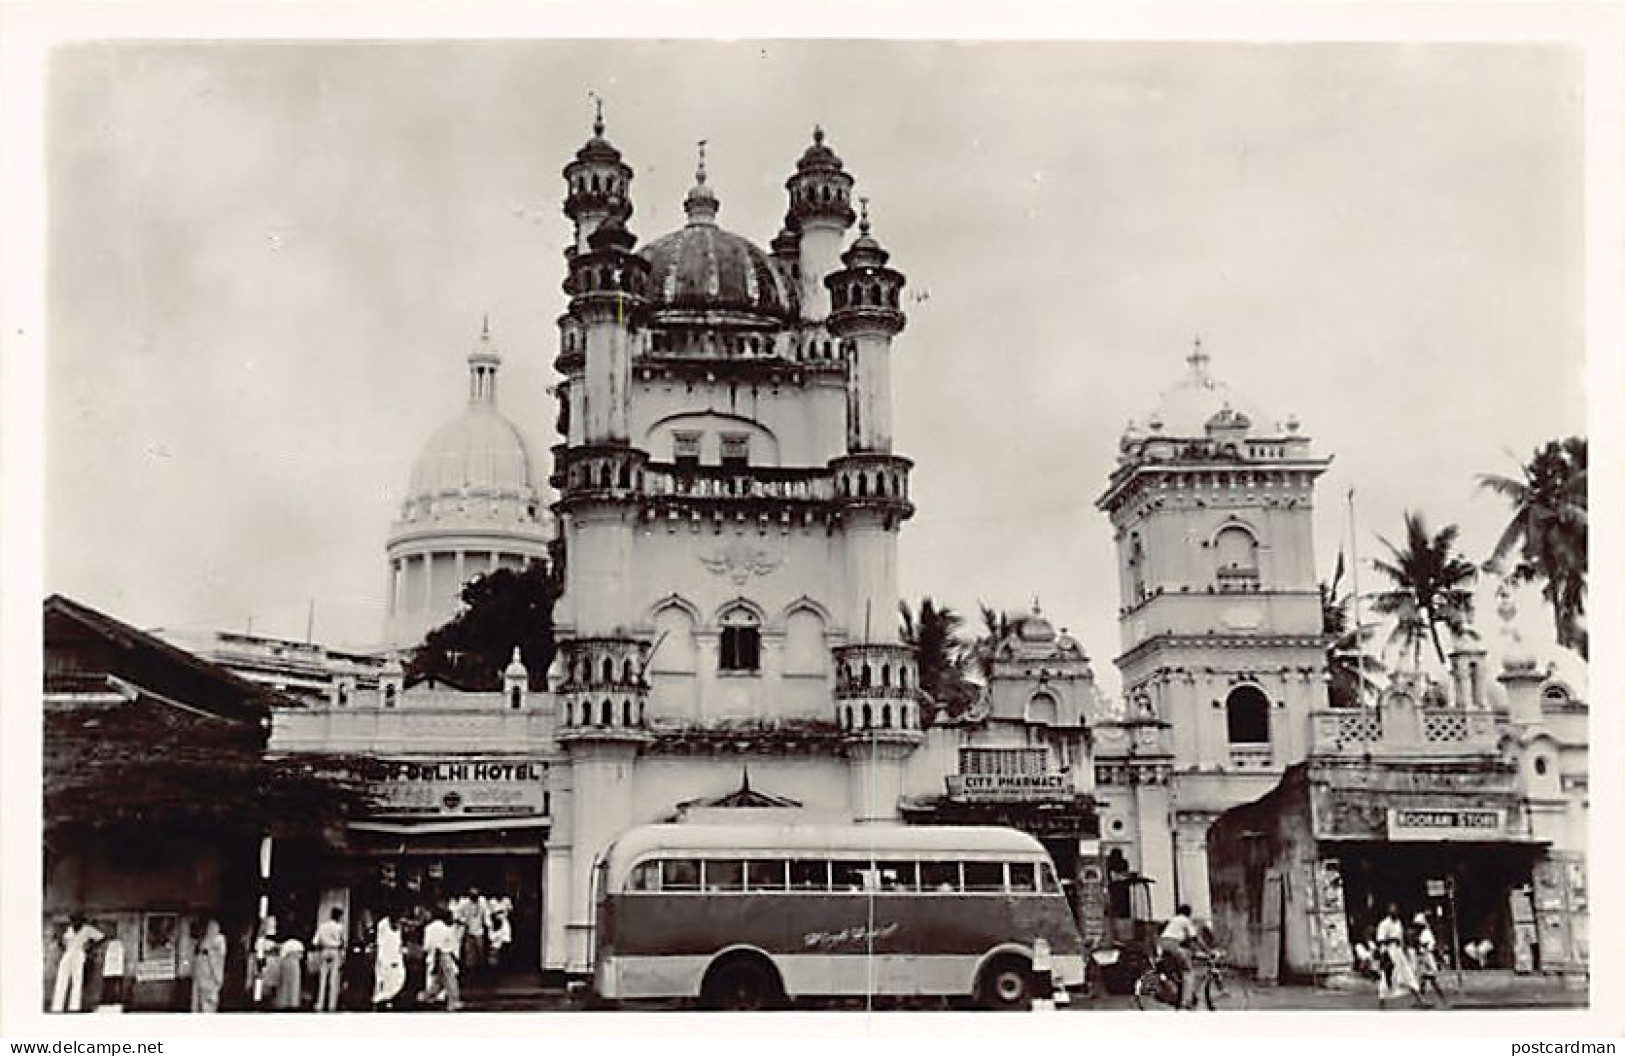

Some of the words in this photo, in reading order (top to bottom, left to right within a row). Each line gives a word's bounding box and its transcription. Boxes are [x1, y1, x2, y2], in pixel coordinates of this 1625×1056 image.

[405, 765, 469, 780] DELHI
[474, 765, 540, 780] HOTEL
[965, 776, 992, 787] CITY
[998, 776, 1063, 787] PHARMACY
